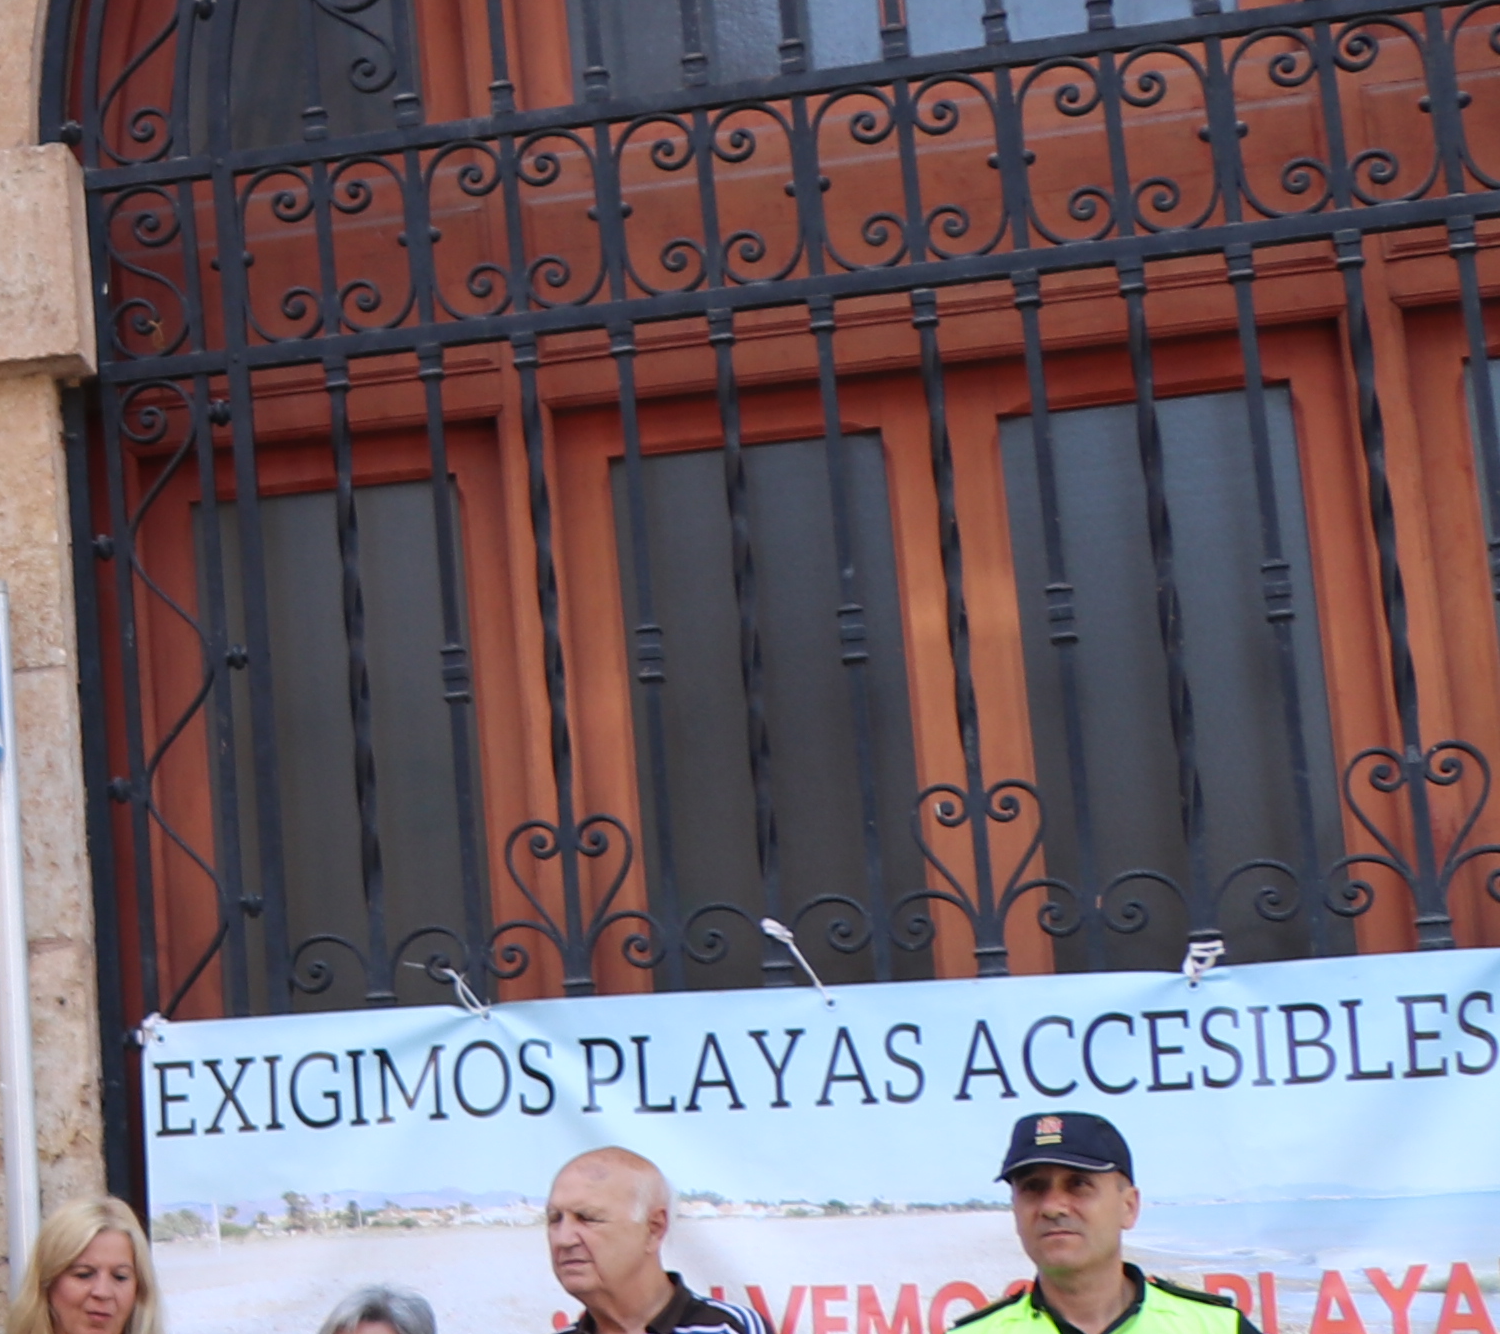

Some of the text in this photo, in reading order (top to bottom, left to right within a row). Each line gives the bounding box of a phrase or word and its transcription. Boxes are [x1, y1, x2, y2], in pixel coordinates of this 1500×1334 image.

[153, 989, 1500, 1138] EXIGIMOS PLAYAS ACCESIBLES
